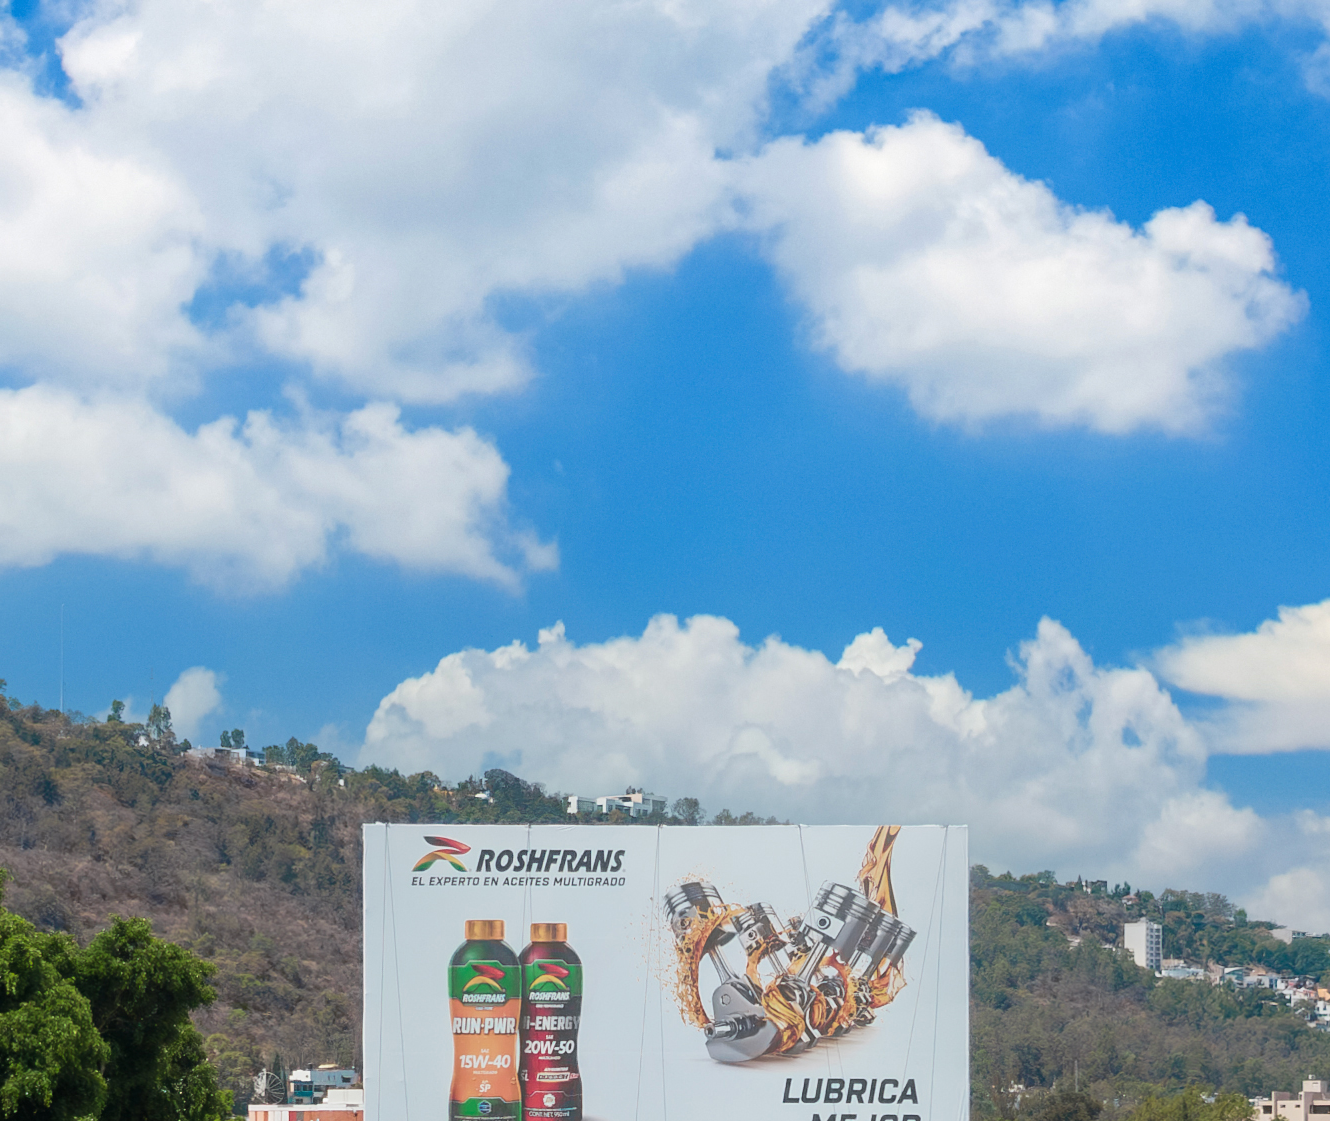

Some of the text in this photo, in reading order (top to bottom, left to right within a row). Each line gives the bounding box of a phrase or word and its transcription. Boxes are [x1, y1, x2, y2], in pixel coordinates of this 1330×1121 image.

[475, 849, 626, 872] ROSHFRANS
[411, 876, 626, 887] EL EXPERTO EN ACEITES MULTIGRADO
[462, 993, 506, 1003] ROSHFRANS
[529, 991, 570, 1001] ROSHFRANS
[524, 1040, 575, 1055] 20W-50
[459, 1054, 511, 1069] 15W-40
[478, 1083, 491, 1093] SP
[782, 1077, 919, 1104] LUBRICA
